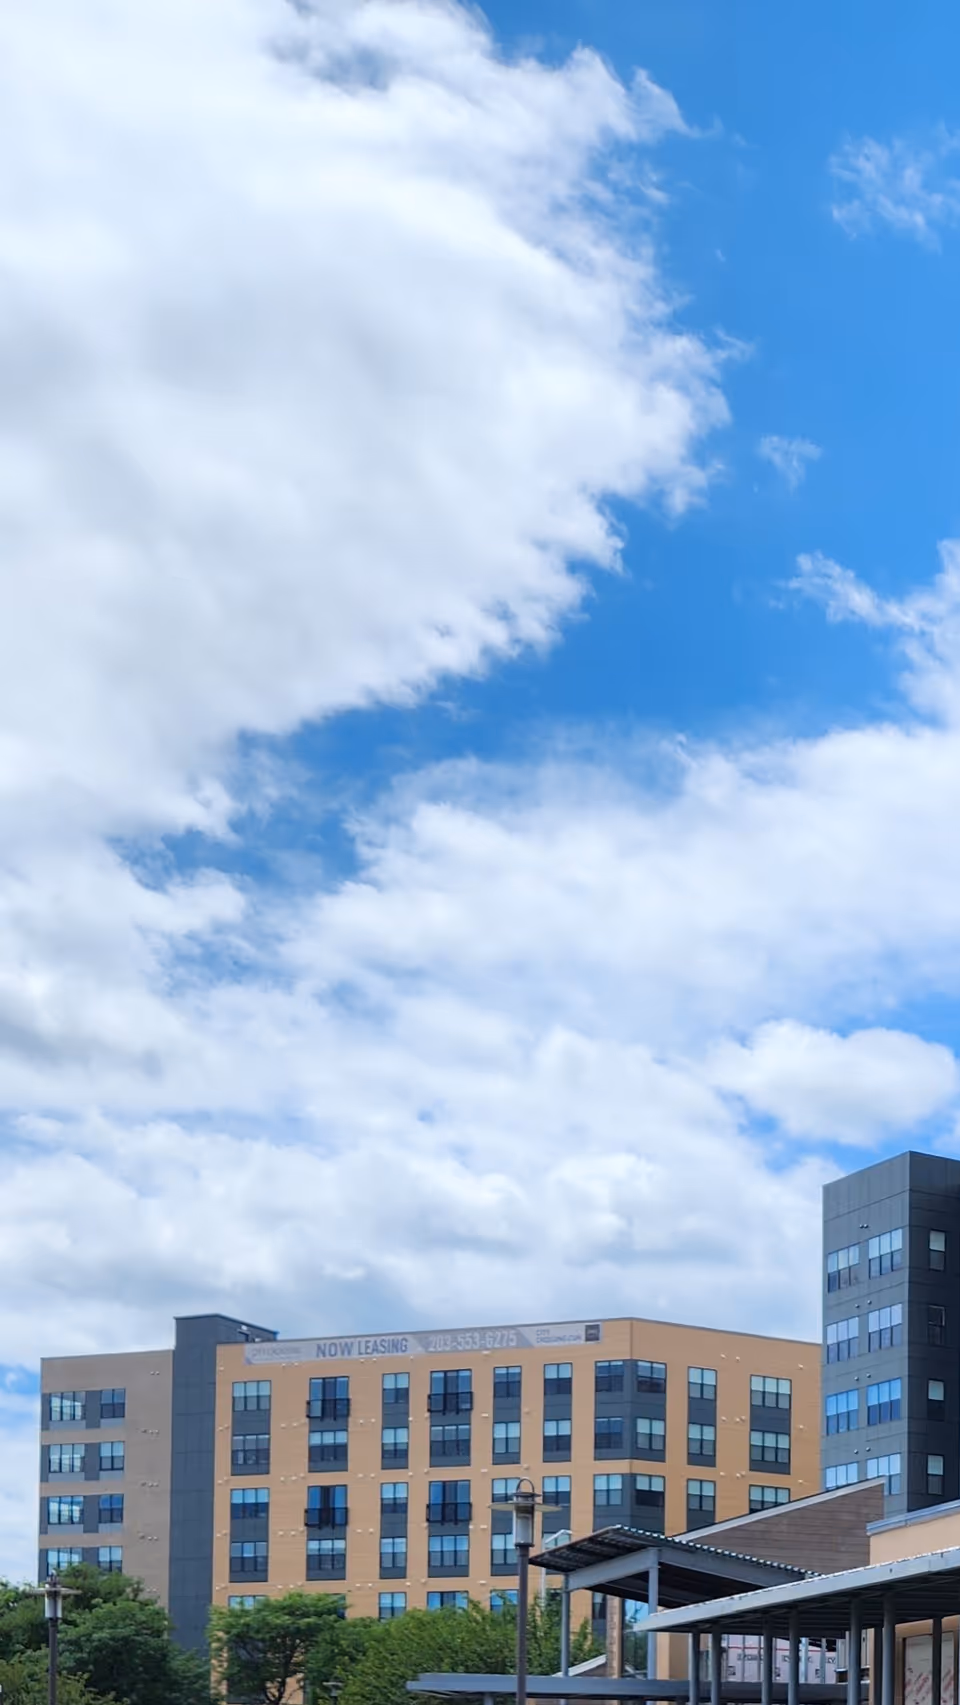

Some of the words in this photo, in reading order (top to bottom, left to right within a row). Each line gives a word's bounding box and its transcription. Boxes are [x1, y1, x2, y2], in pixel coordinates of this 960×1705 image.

[316, 1341, 353, 1358] NOW
[357, 1337, 409, 1355] LEASING
[428, 1330, 517, 1351] 203-553-6275
